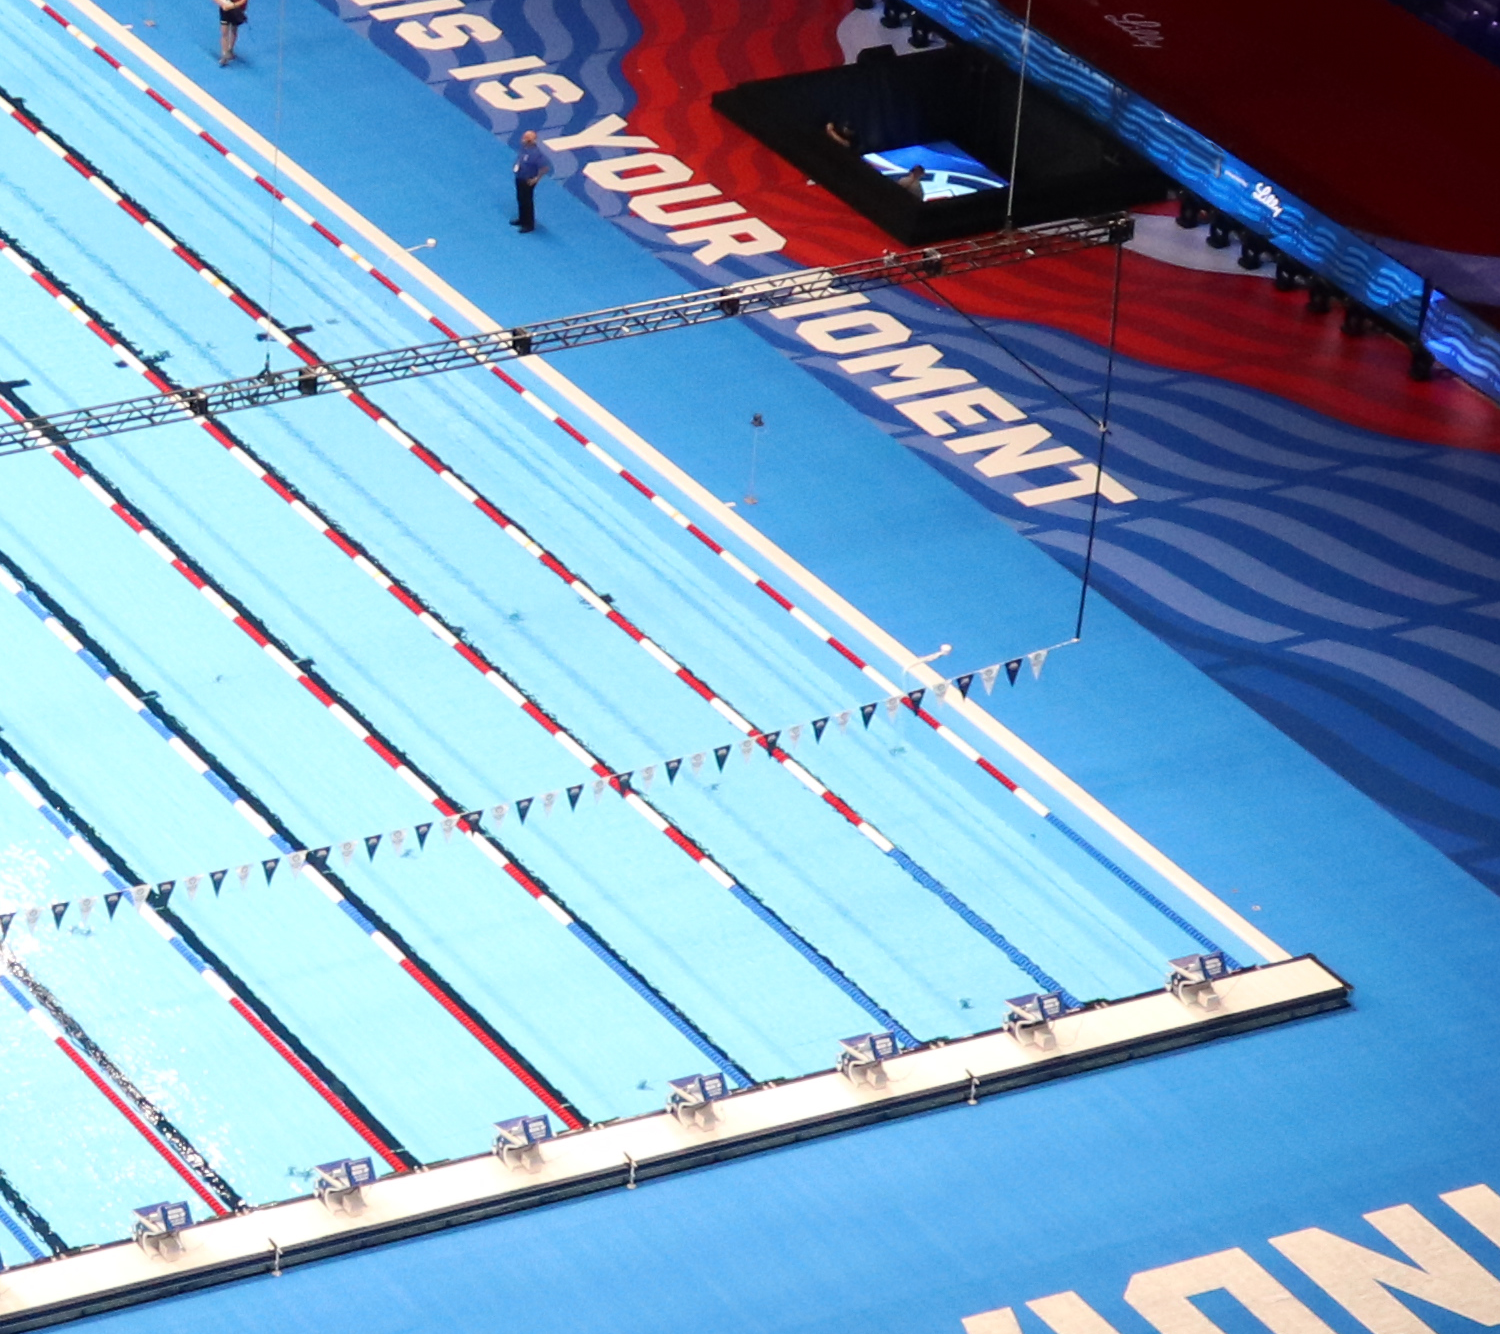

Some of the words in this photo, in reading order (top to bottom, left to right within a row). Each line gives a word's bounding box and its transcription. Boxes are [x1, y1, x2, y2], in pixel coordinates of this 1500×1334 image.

[1103, 12, 1165, 49] Lilly
[448, 54, 585, 113] IS
[543, 114, 787, 266] YOUR
[1251, 180, 1284, 218] Lilly
